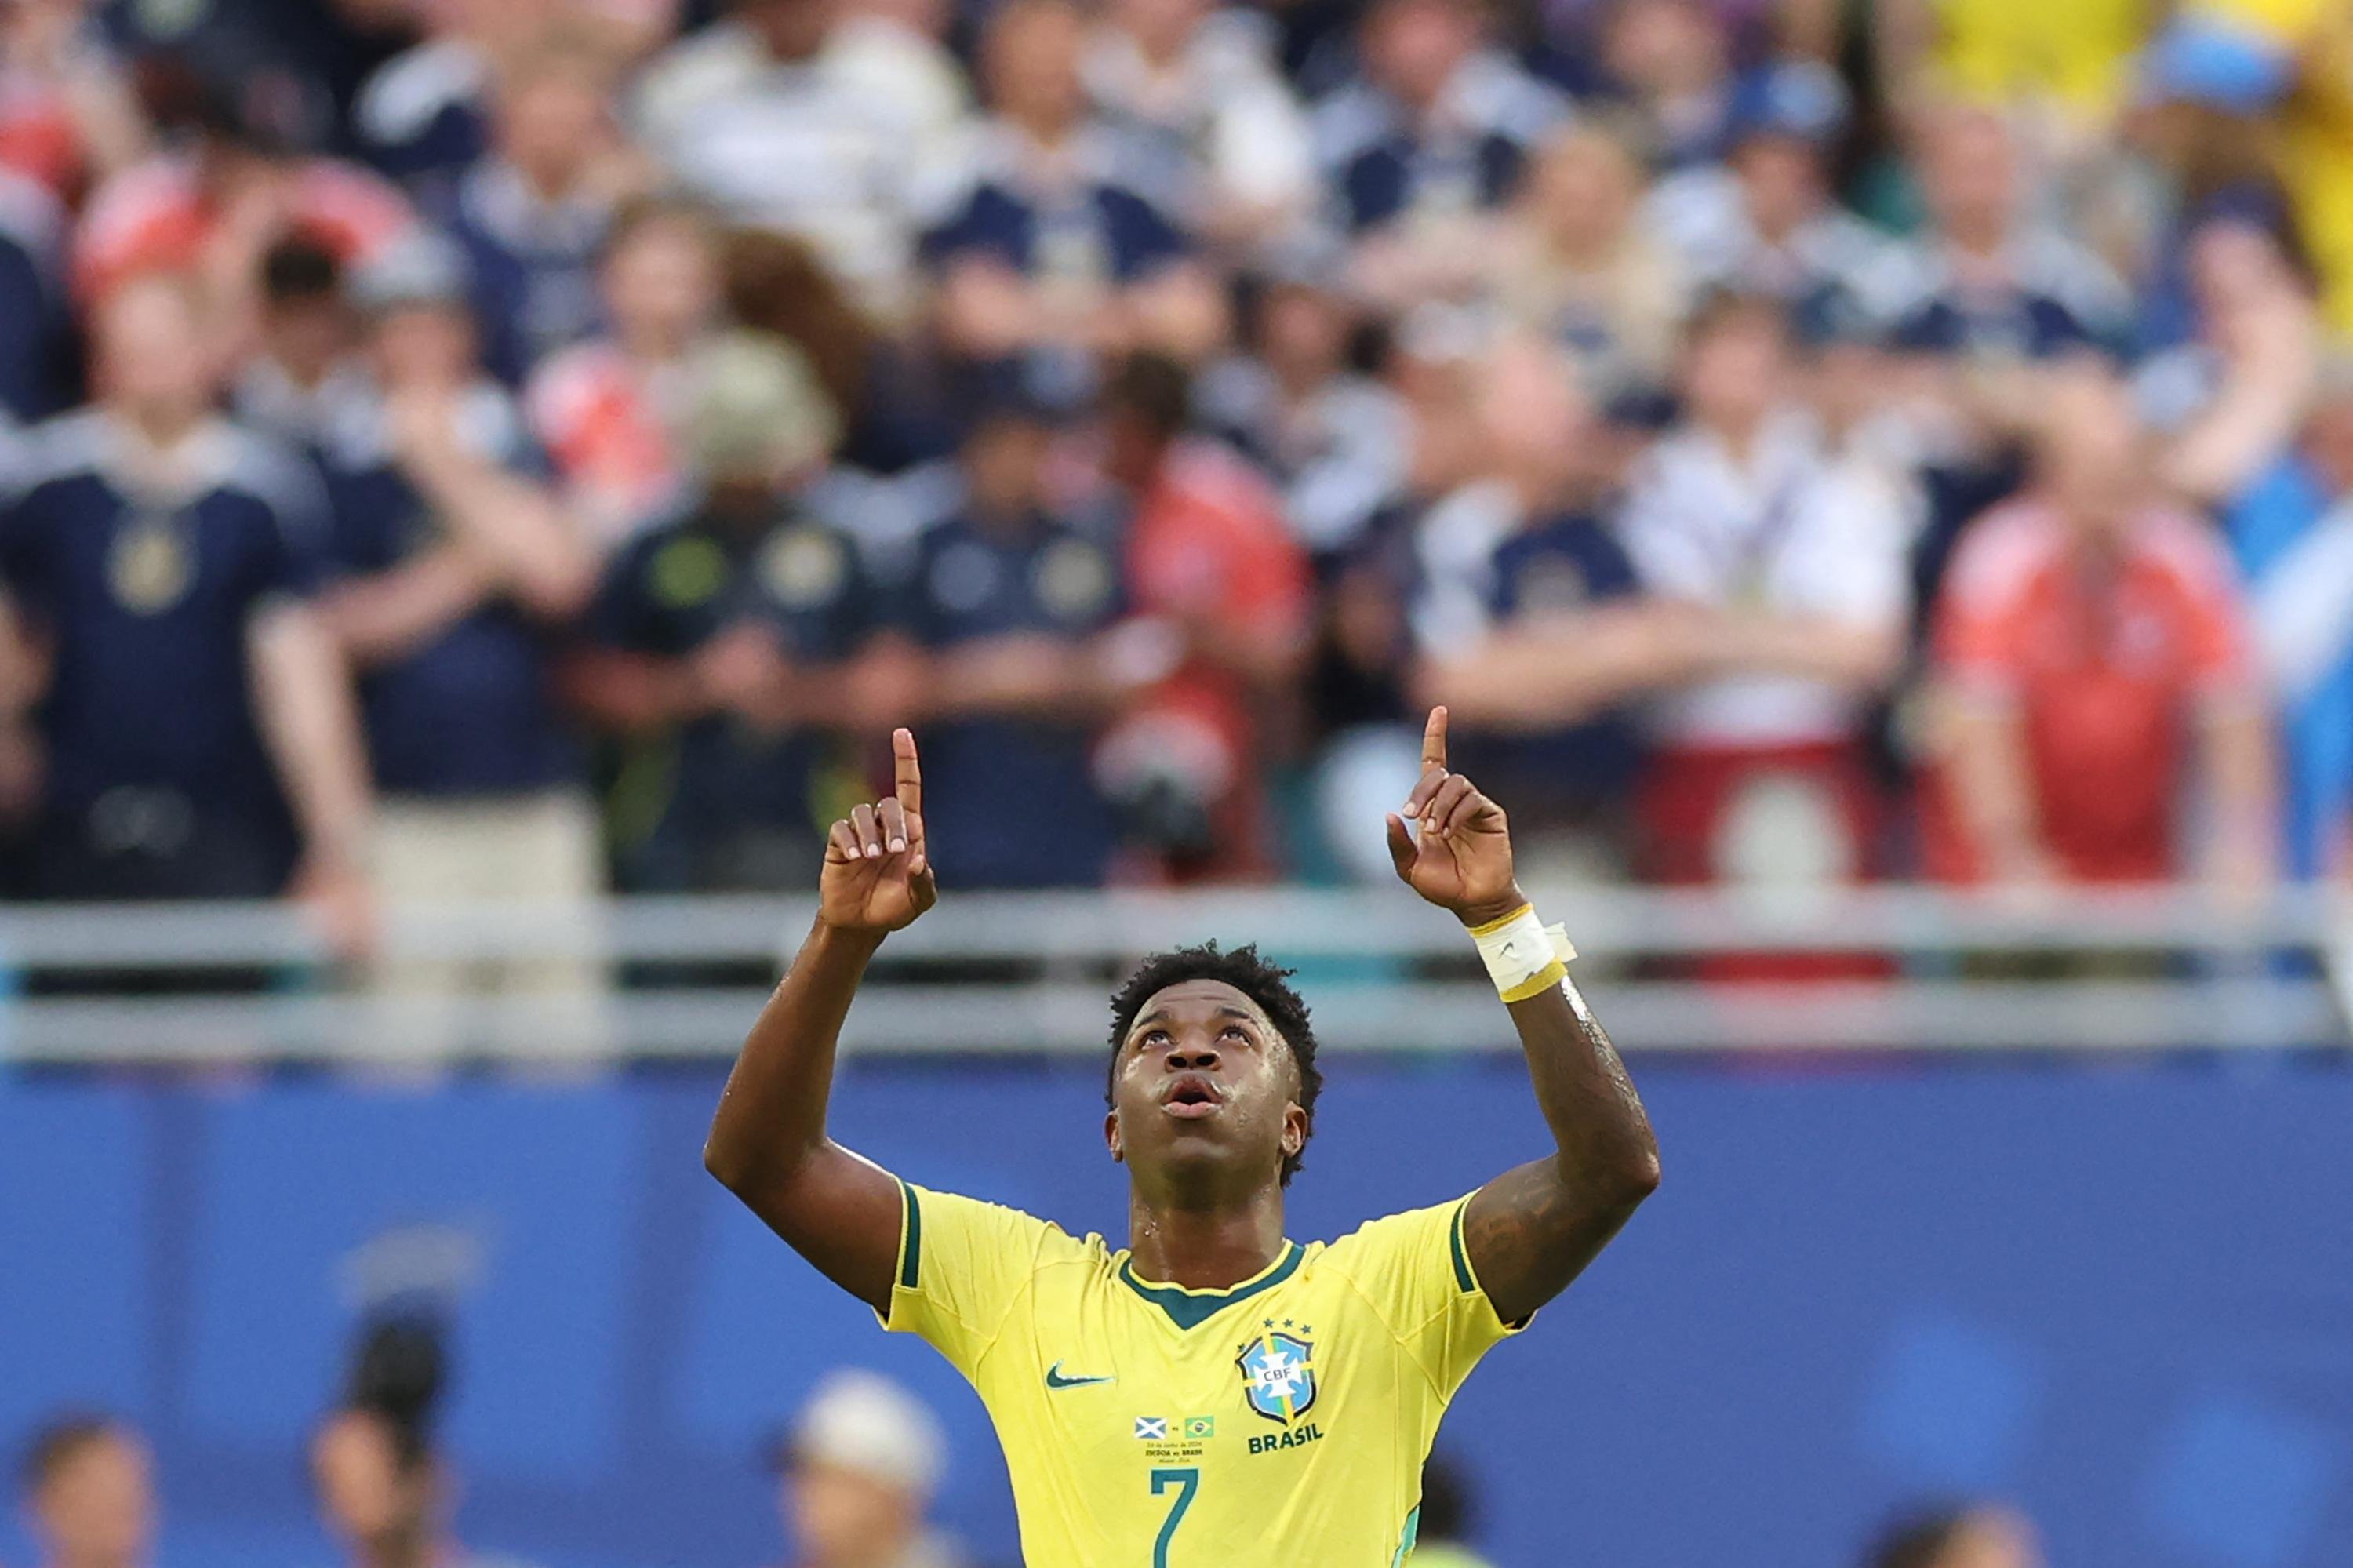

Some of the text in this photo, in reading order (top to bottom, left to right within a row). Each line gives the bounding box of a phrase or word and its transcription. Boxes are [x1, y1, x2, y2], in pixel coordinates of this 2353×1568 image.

[1264, 1367, 1292, 1381] CBF
[1248, 1423, 1324, 1455] BRASIL
[1151, 1468, 1198, 1568] 7
